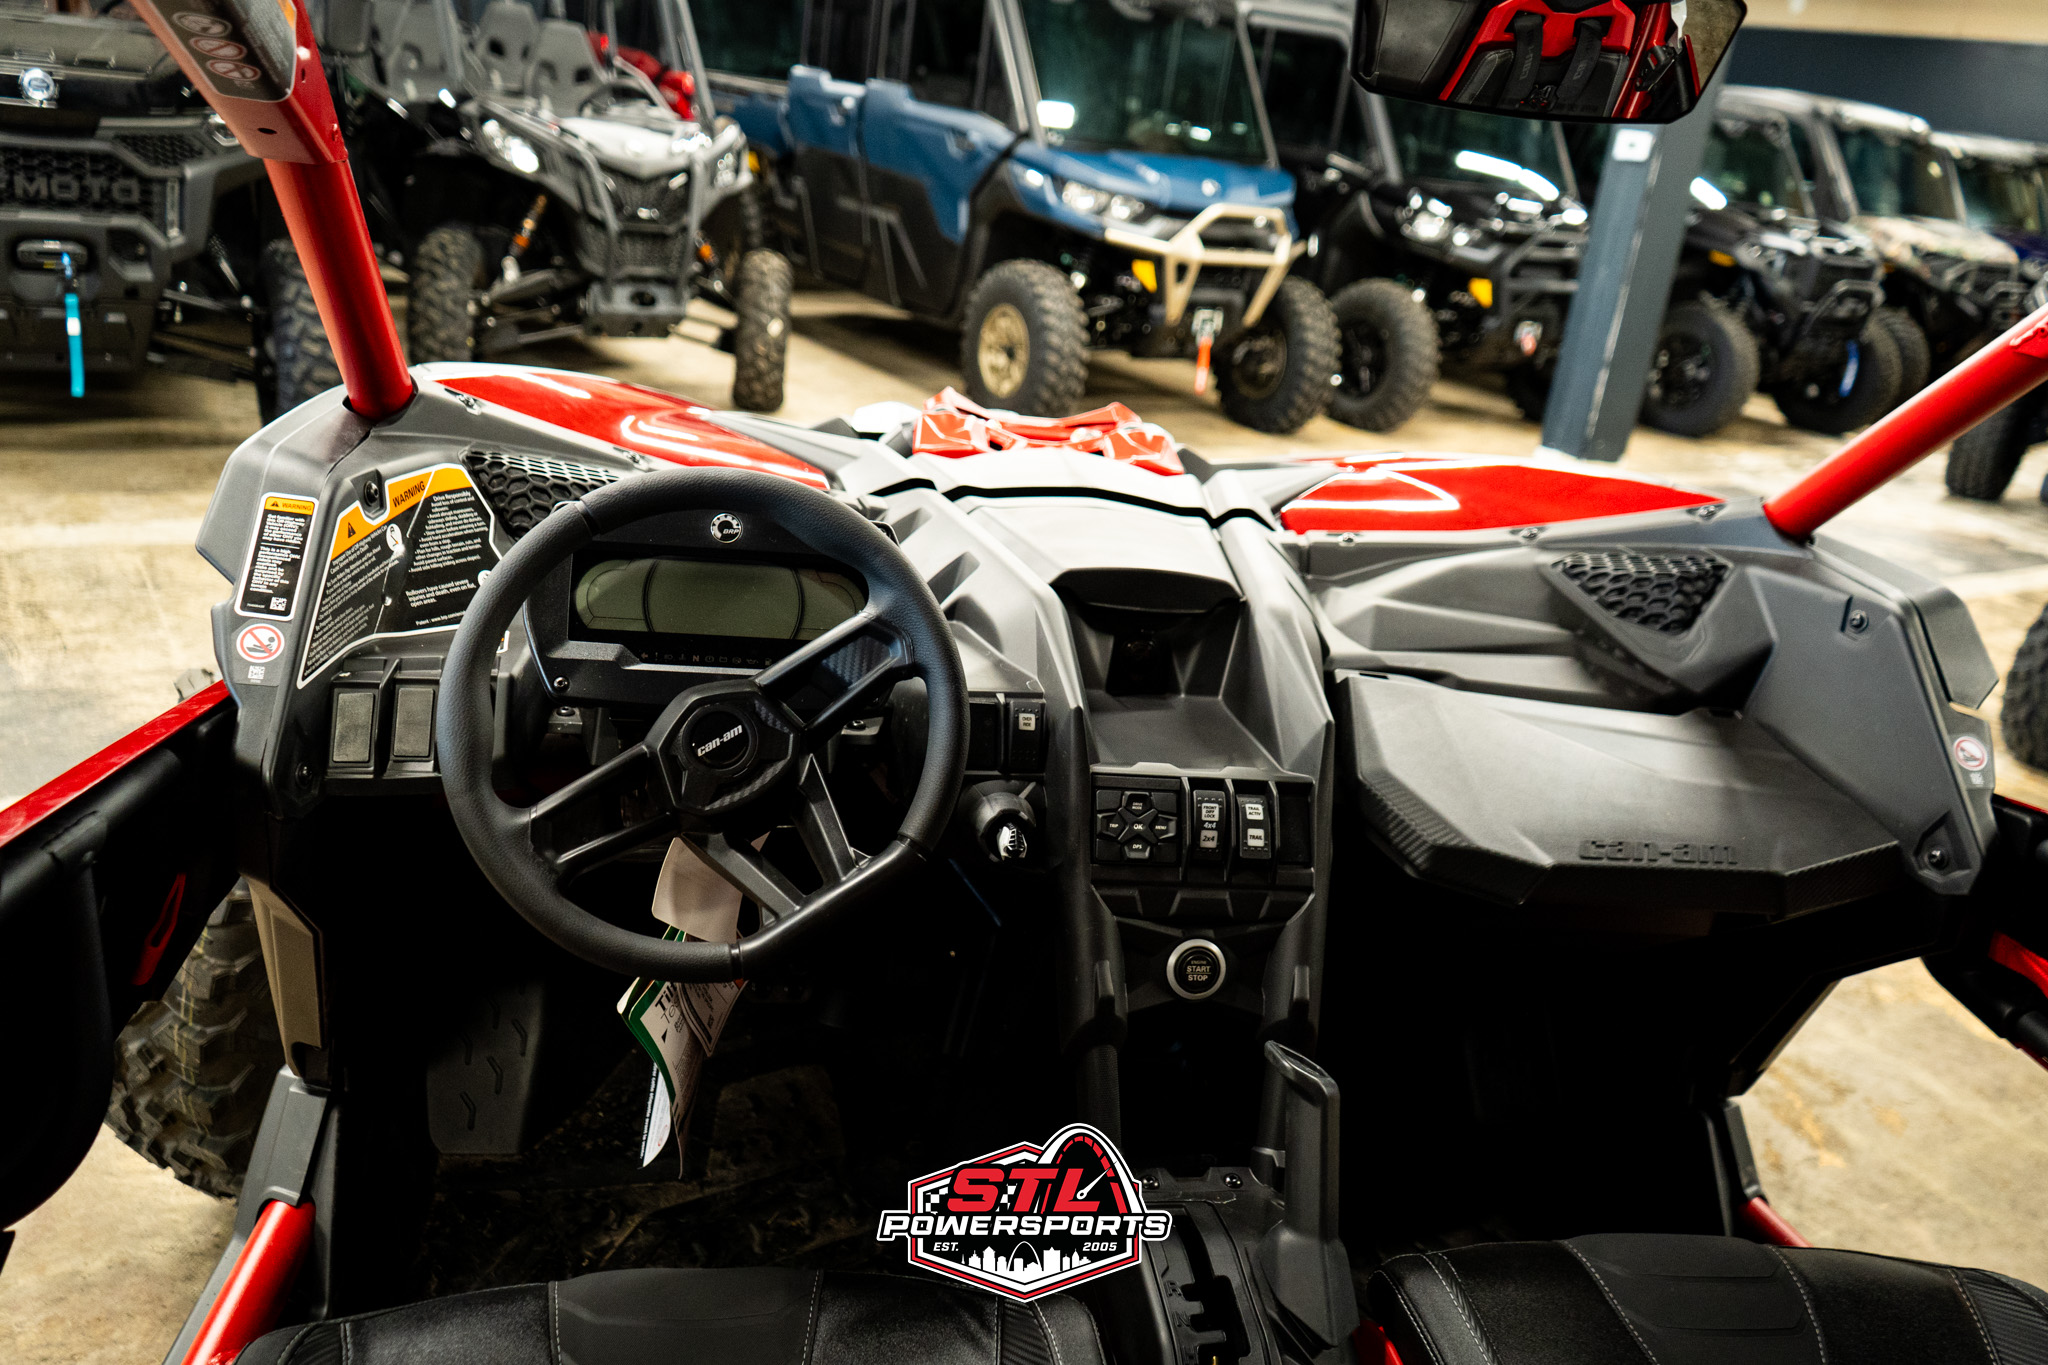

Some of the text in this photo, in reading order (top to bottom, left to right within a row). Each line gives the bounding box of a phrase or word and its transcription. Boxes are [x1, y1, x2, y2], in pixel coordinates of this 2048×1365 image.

[392, 481, 426, 508] WARNING
[445, 491, 471, 499] Responsibly
[282, 503, 312, 511] WARNING
[405, 587, 427, 596] Rollovers
[697, 723, 743, 757] can-am
[1579, 840, 1738, 865] can-am
